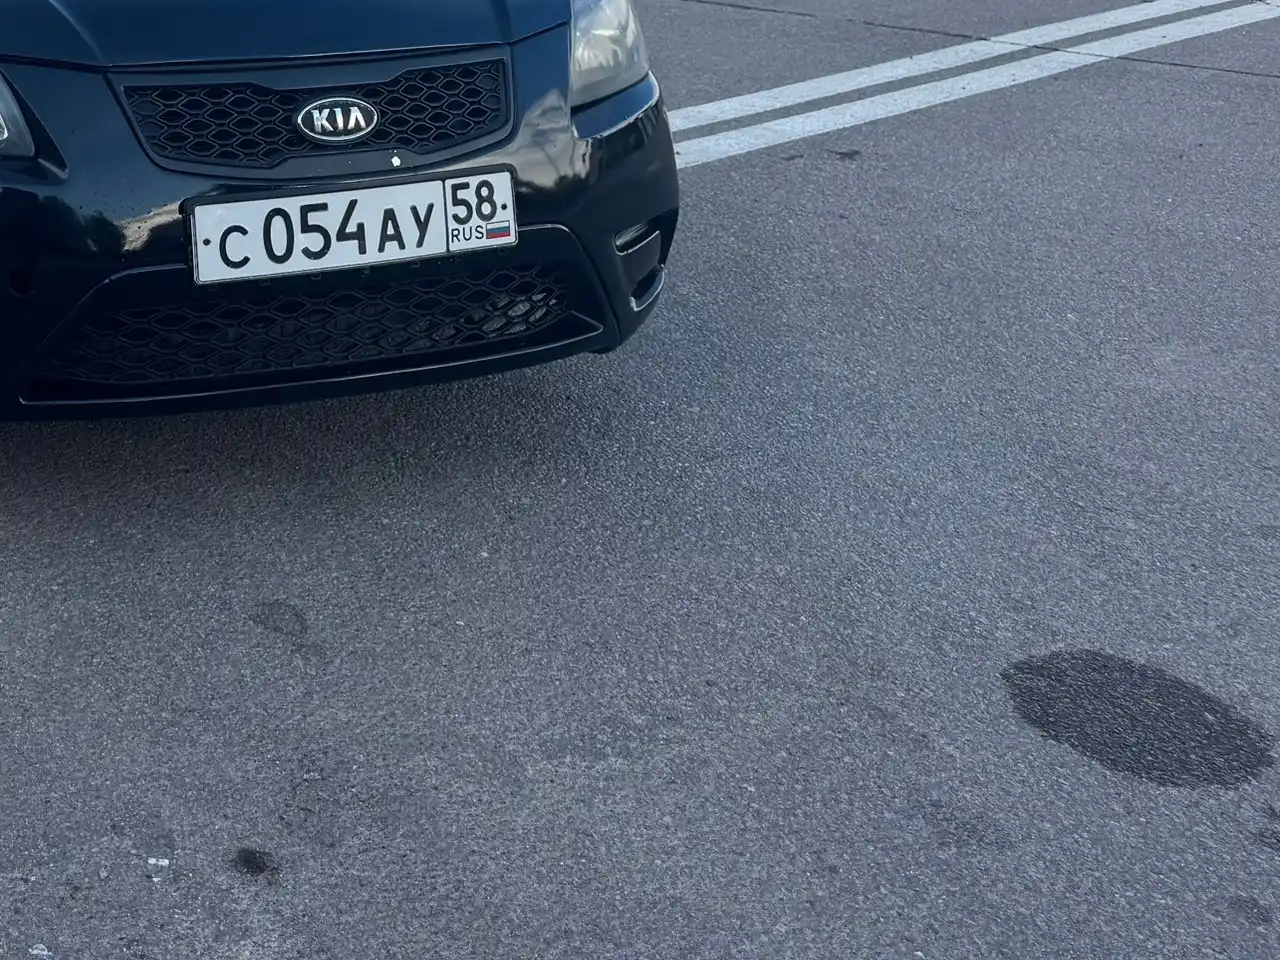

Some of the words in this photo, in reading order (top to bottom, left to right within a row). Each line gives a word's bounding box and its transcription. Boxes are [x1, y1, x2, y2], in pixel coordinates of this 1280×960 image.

[310, 106, 368, 132] KIA
[450, 179, 498, 226] 58
[450, 225, 485, 244] RUS
